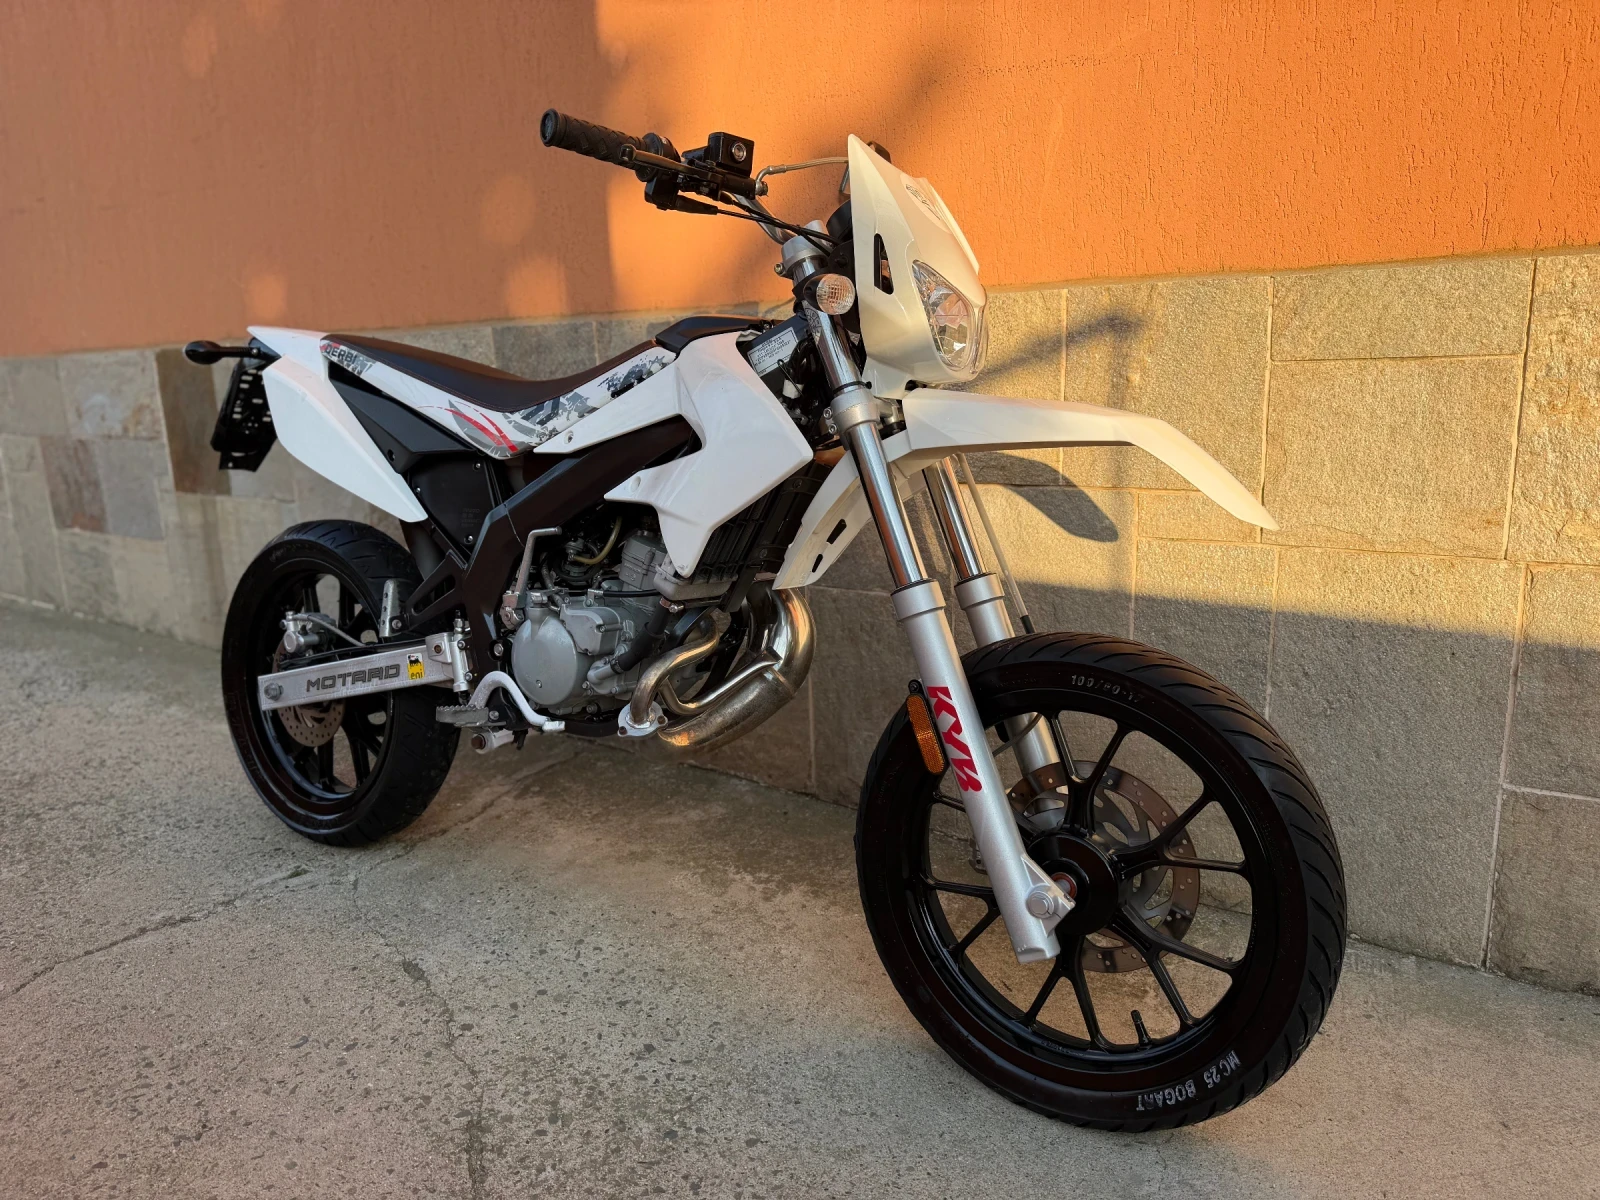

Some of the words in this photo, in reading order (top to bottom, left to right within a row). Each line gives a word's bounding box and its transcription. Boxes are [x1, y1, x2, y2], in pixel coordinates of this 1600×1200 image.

[325, 343, 358, 364] DERBI
[306, 664, 400, 692] MOTARD
[410, 671, 424, 680] eni
[926, 685, 983, 792] KYB
[1219, 1050, 1241, 1076] MC
[1203, 1065, 1221, 1088] 25
[1136, 1079, 1197, 1111] BOGART
